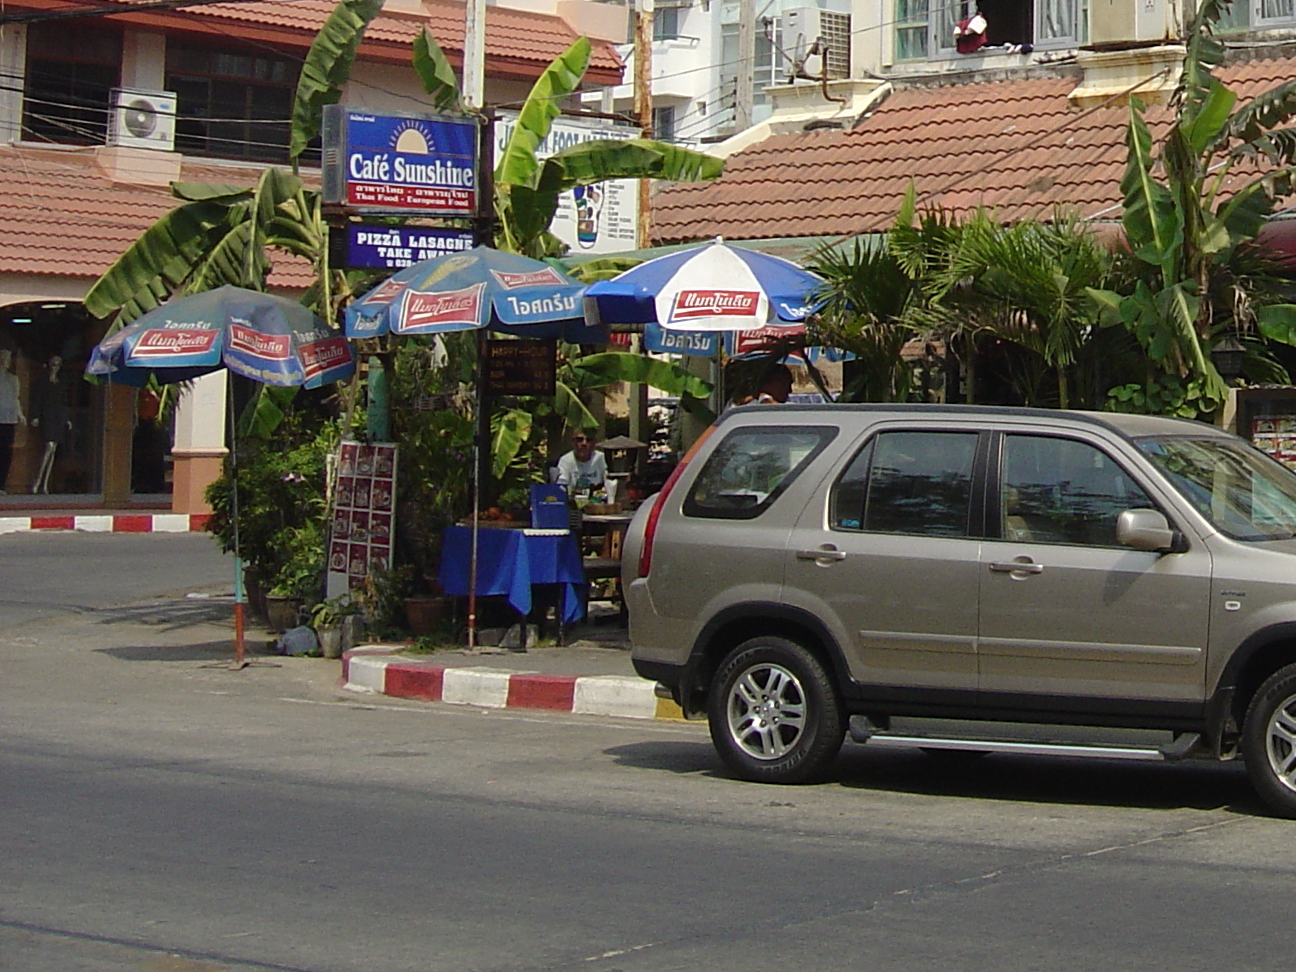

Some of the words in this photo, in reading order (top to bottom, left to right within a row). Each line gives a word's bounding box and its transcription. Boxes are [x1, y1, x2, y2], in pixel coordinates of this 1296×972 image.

[350, 153, 390, 181] Café
[394, 157, 473, 187] Sunshine
[355, 192, 375, 201] Thai
[377, 194, 399, 203] Food
[406, 195, 446, 206] European
[449, 198, 469, 207] Food
[357, 232, 402, 247] PIZZA
[408, 236, 474, 251] LASAGNE
[377, 247, 412, 259] TAKE
[418, 249, 454, 260] AWA
[507, 293, 575, 316] ไอศกรีม
